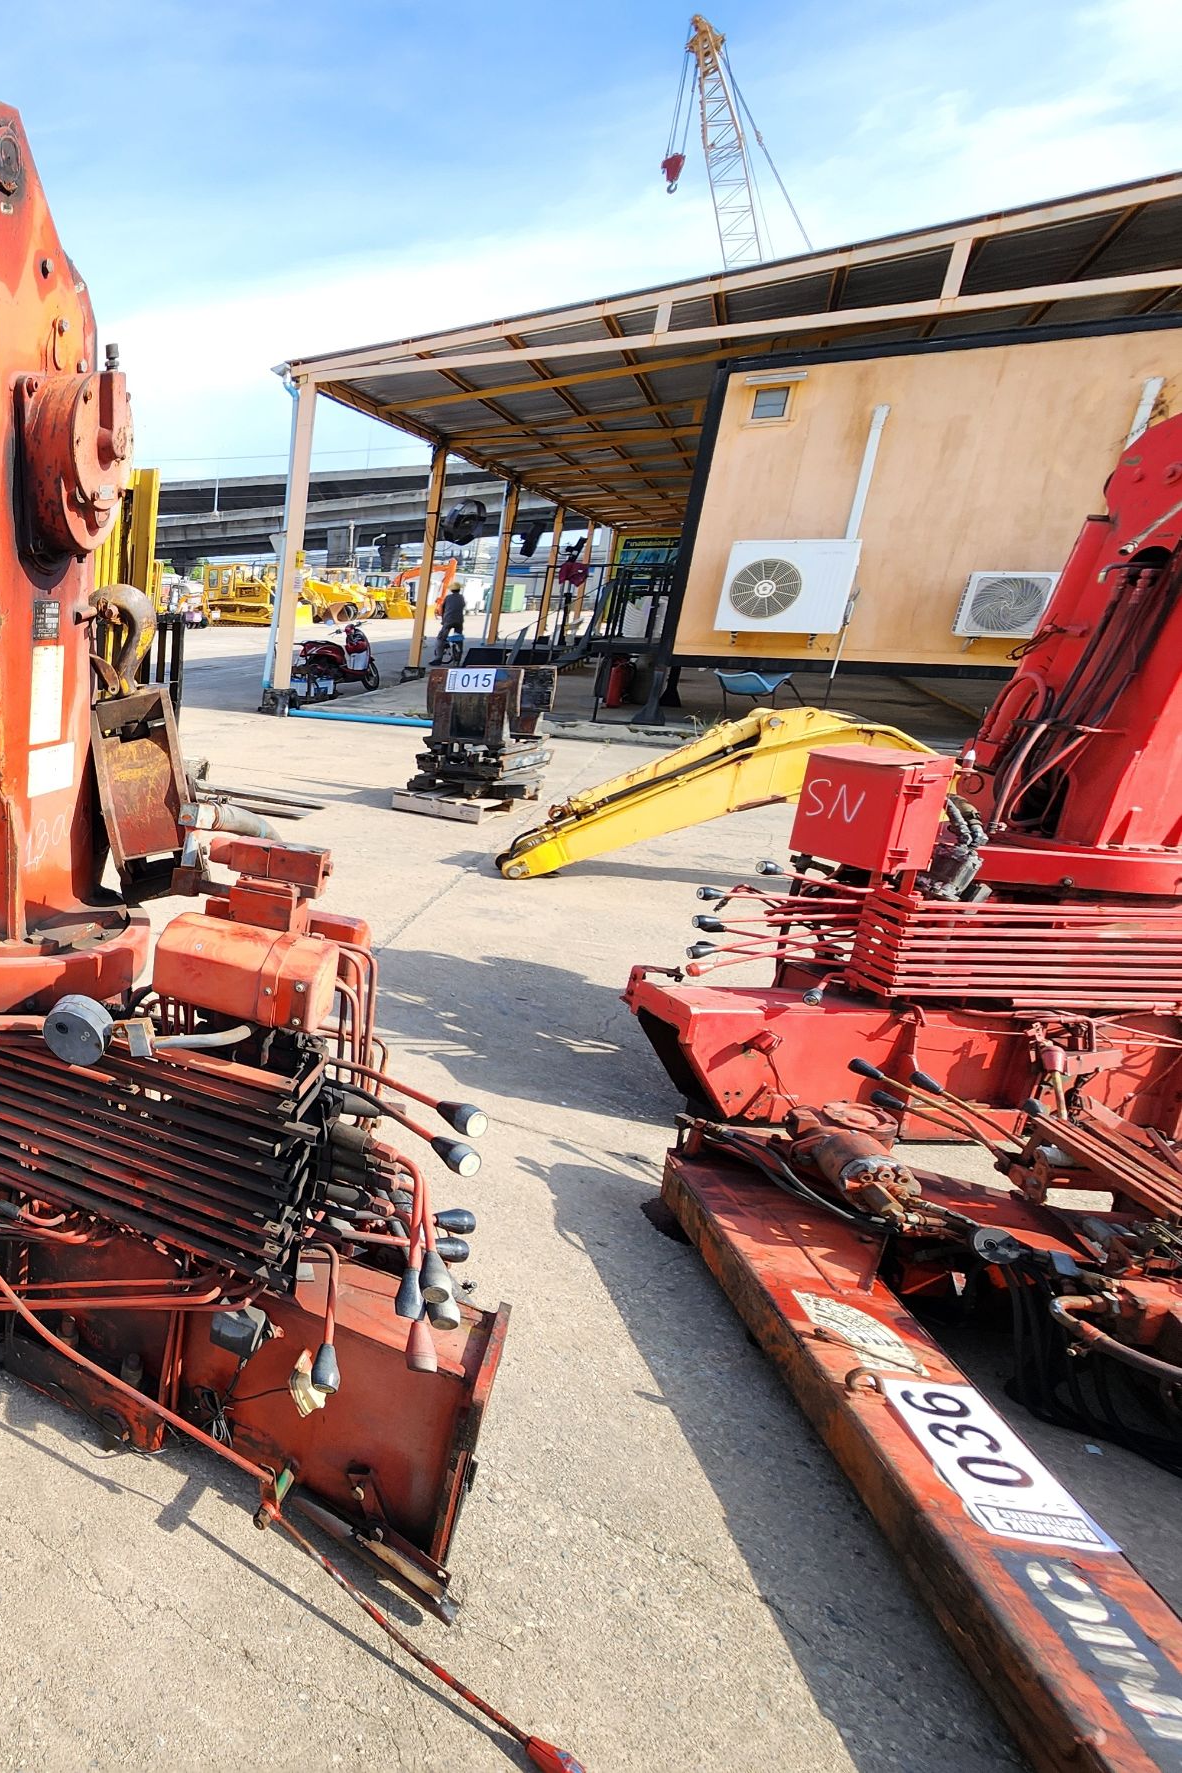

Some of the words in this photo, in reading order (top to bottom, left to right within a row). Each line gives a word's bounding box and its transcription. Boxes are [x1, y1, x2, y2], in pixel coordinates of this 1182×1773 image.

[461, 673, 492, 688] 015
[806, 778, 866, 823] SN
[900, 1389, 1035, 1489] 036
[1025, 1560, 1182, 1741] NIC
